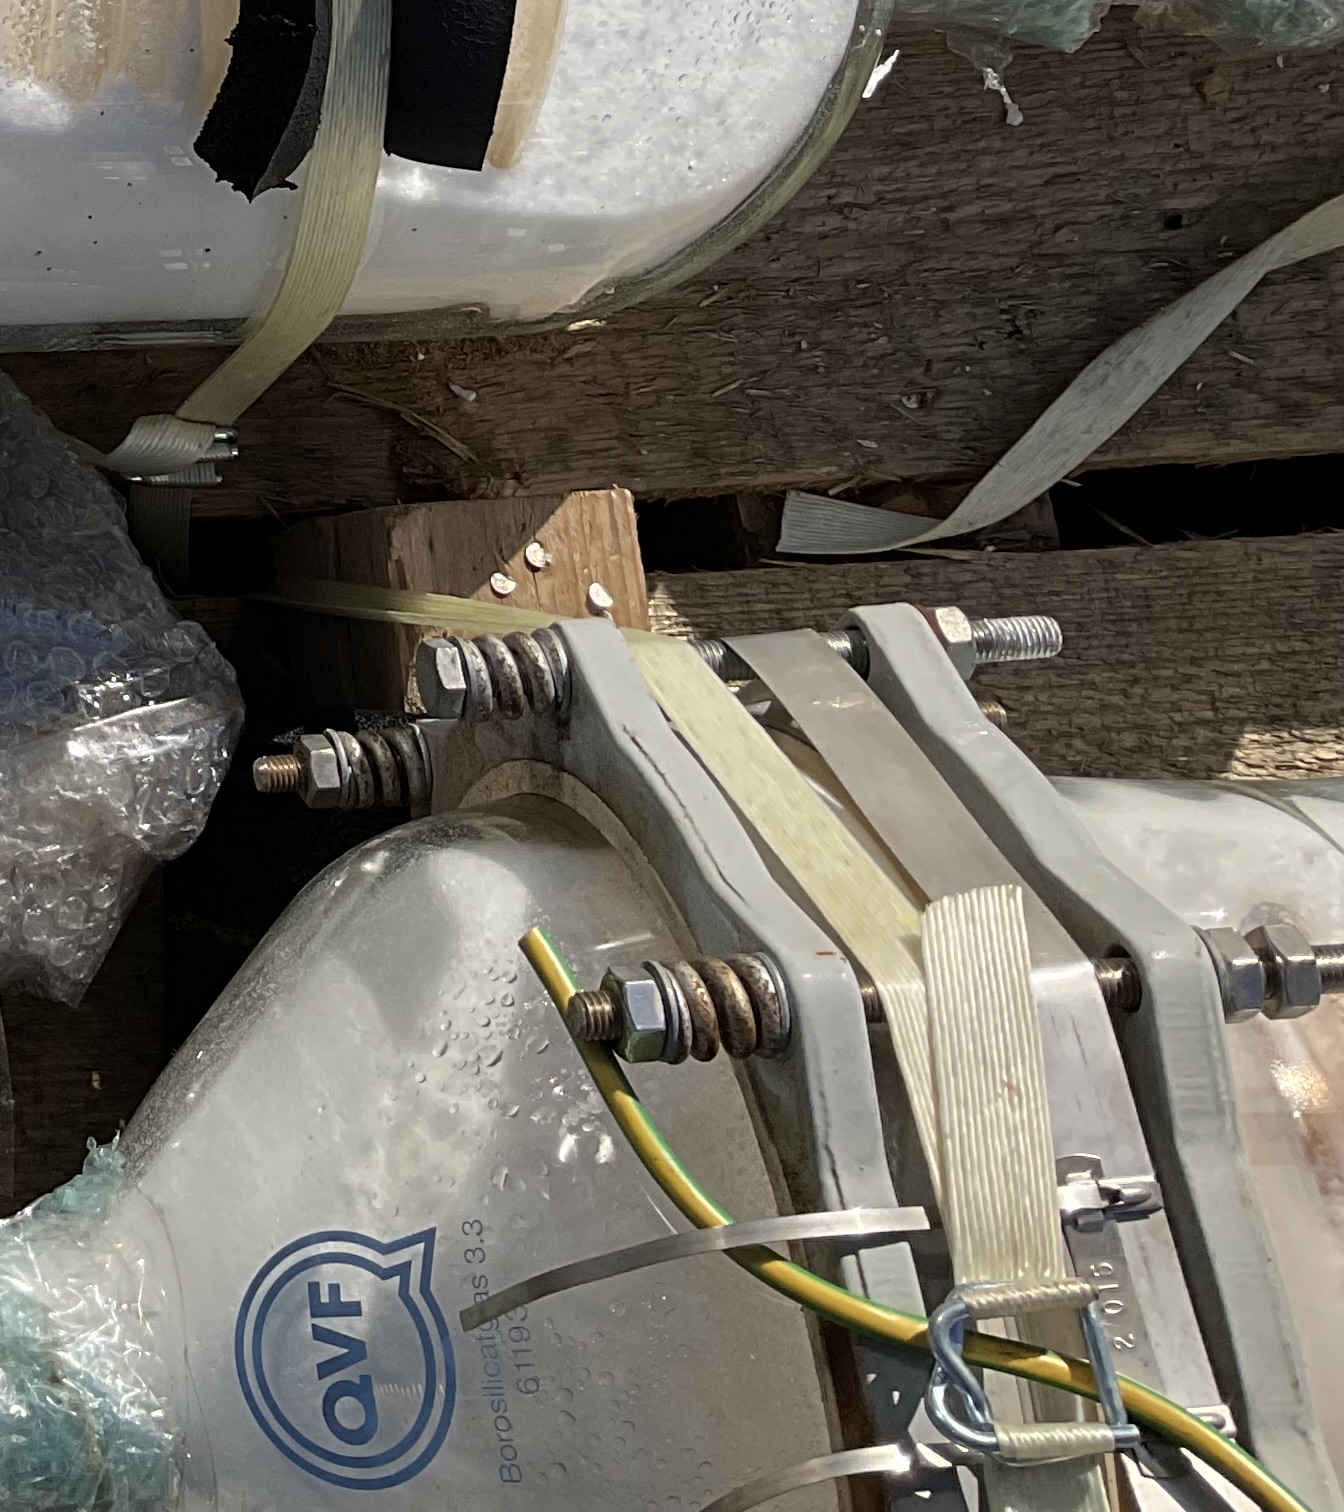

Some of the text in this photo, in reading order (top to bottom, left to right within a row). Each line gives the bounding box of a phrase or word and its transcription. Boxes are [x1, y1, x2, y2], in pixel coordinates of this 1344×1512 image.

[307, 1281, 378, 1446] QVF
[462, 1219, 524, 1483] Borosilicatgas 3.3
